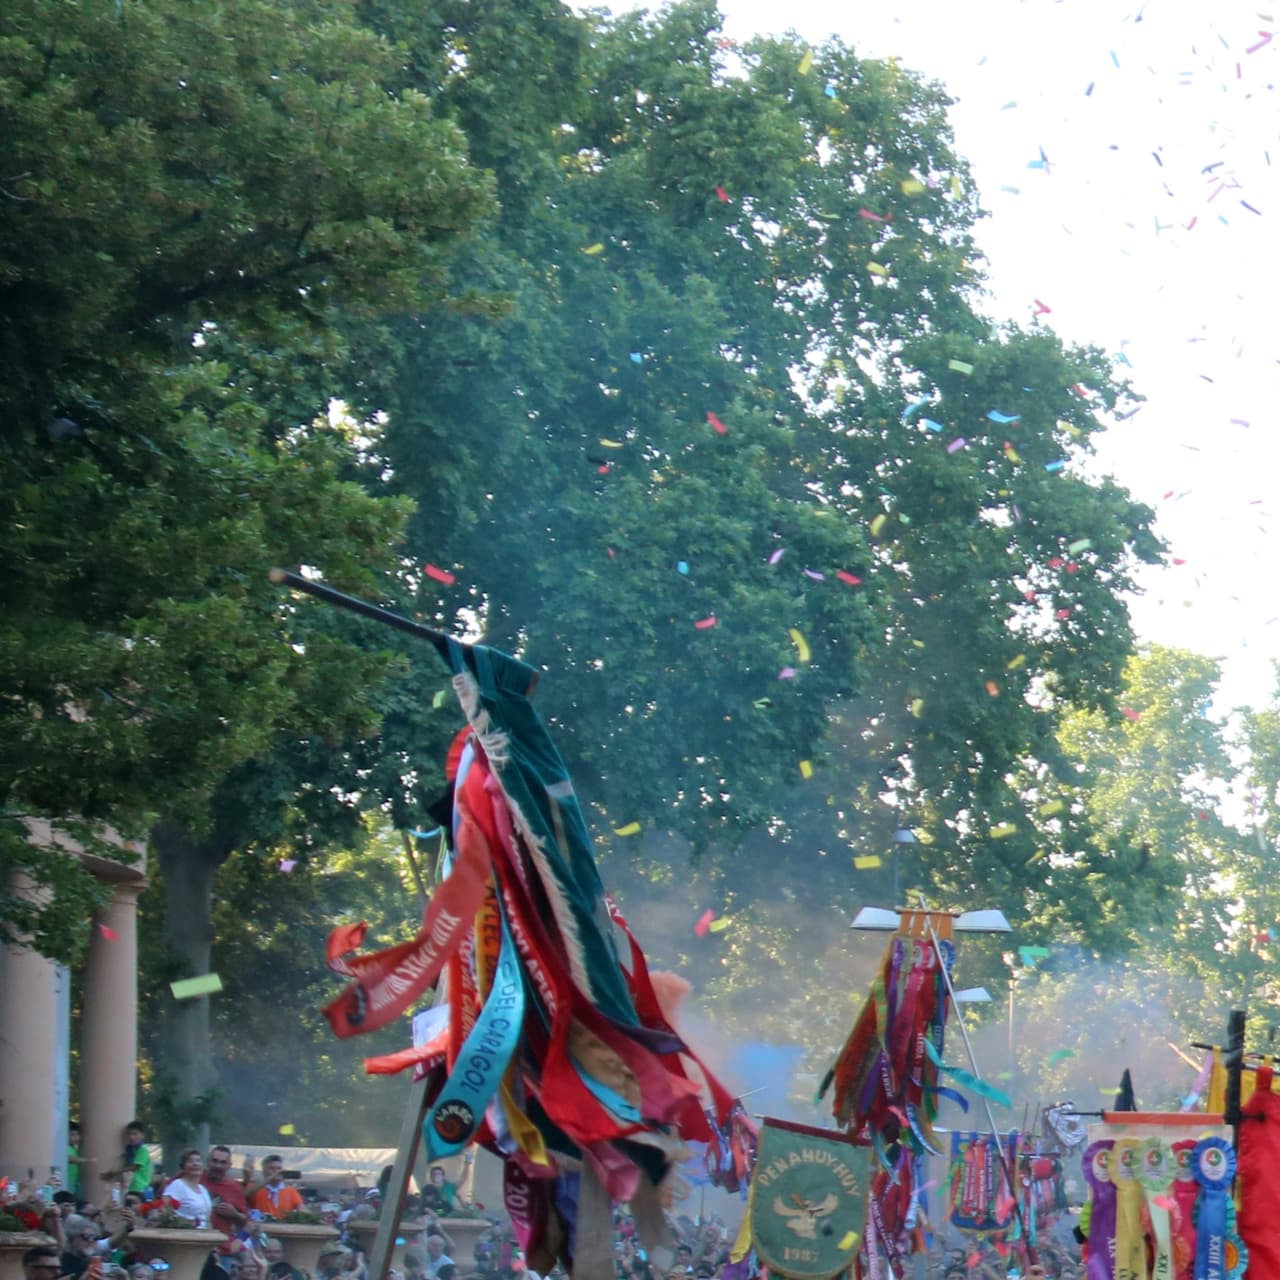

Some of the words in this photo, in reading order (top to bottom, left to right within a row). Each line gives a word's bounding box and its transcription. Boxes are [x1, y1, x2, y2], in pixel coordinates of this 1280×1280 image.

[501, 980, 517, 1012] DEL
[460, 1017, 510, 1094] CARAGOL
[1157, 1252, 1169, 1276] XXI
[1207, 1234, 1222, 1265] XXIII
